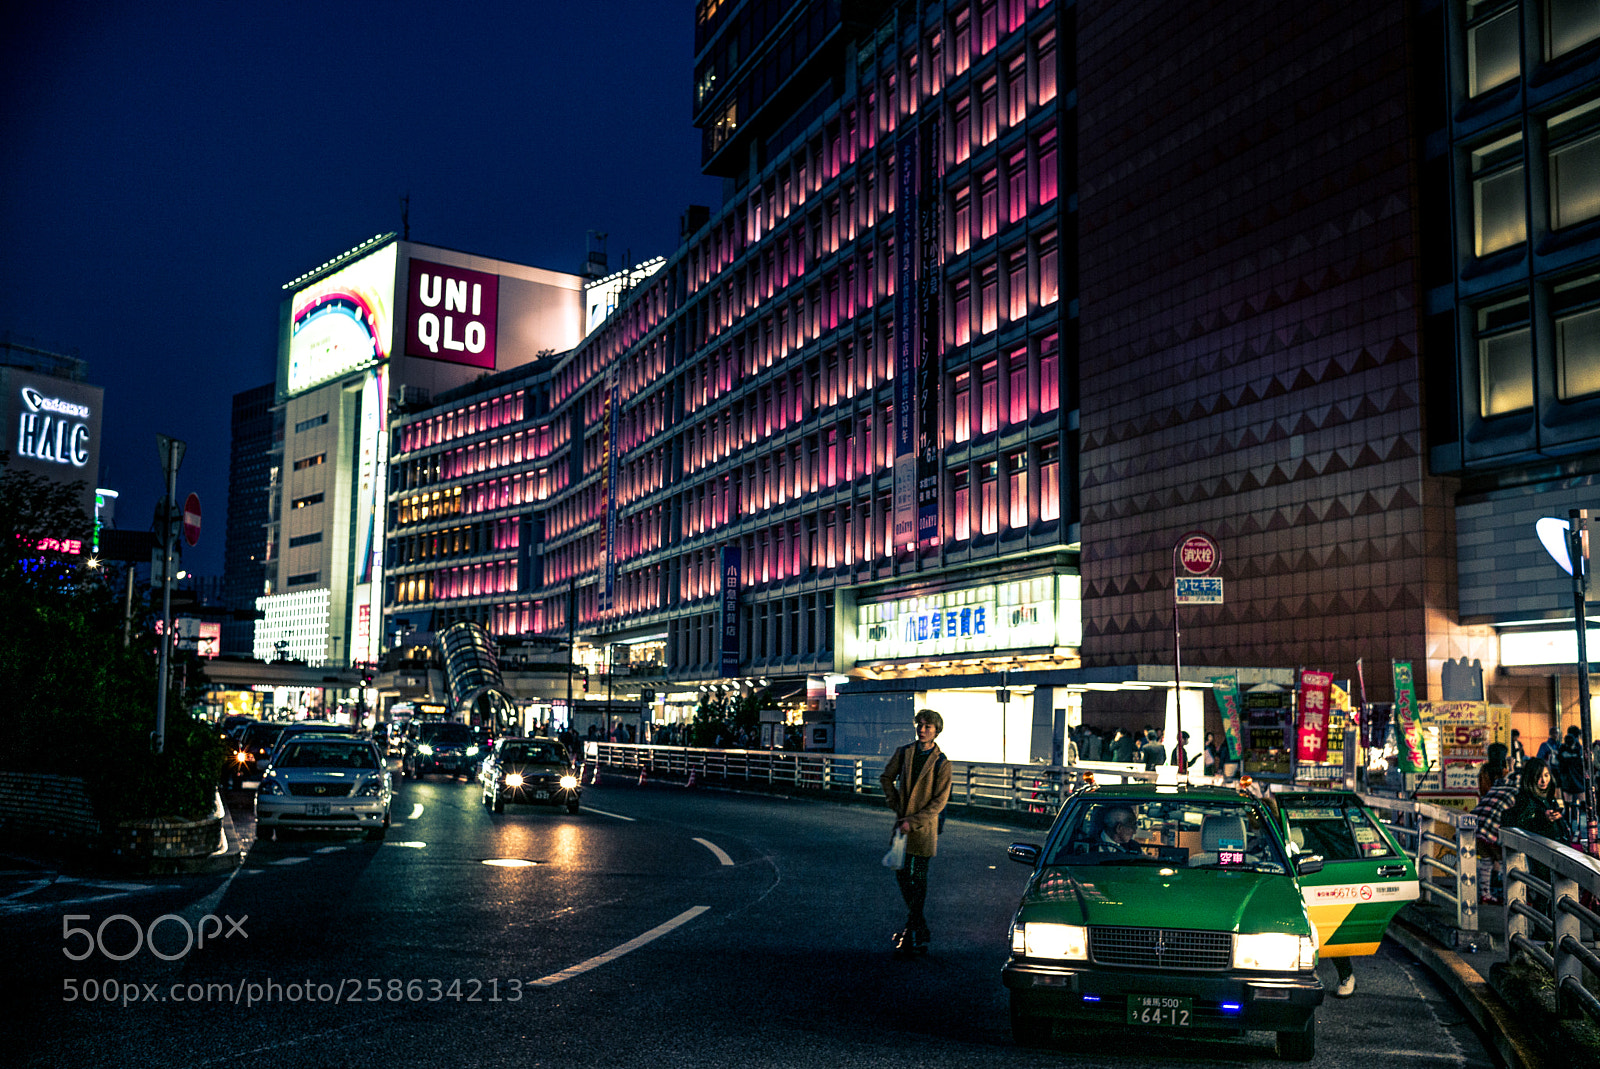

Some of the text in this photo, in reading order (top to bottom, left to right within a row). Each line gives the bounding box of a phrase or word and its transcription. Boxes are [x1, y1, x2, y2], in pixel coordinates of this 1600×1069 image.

[419, 272, 482, 316] UNI
[418, 312, 486, 354] QLO
[18, 413, 90, 467] HALC
[1184, 547, 1211, 563] 消火栓
[1189, 578, 1221, 592] セキネ
[726, 564, 738, 636] 小田急百貨店
[905, 606, 986, 642] 小田急百貨店
[1302, 690, 1324, 752] 発売中
[1455, 726, 1470, 744] 5
[1219, 851, 1244, 865] 空車
[1333, 887, 1357, 899] 6676
[1142, 996, 1179, 1008] 練馬 500
[1141, 1007, 1190, 1026] 64-12
